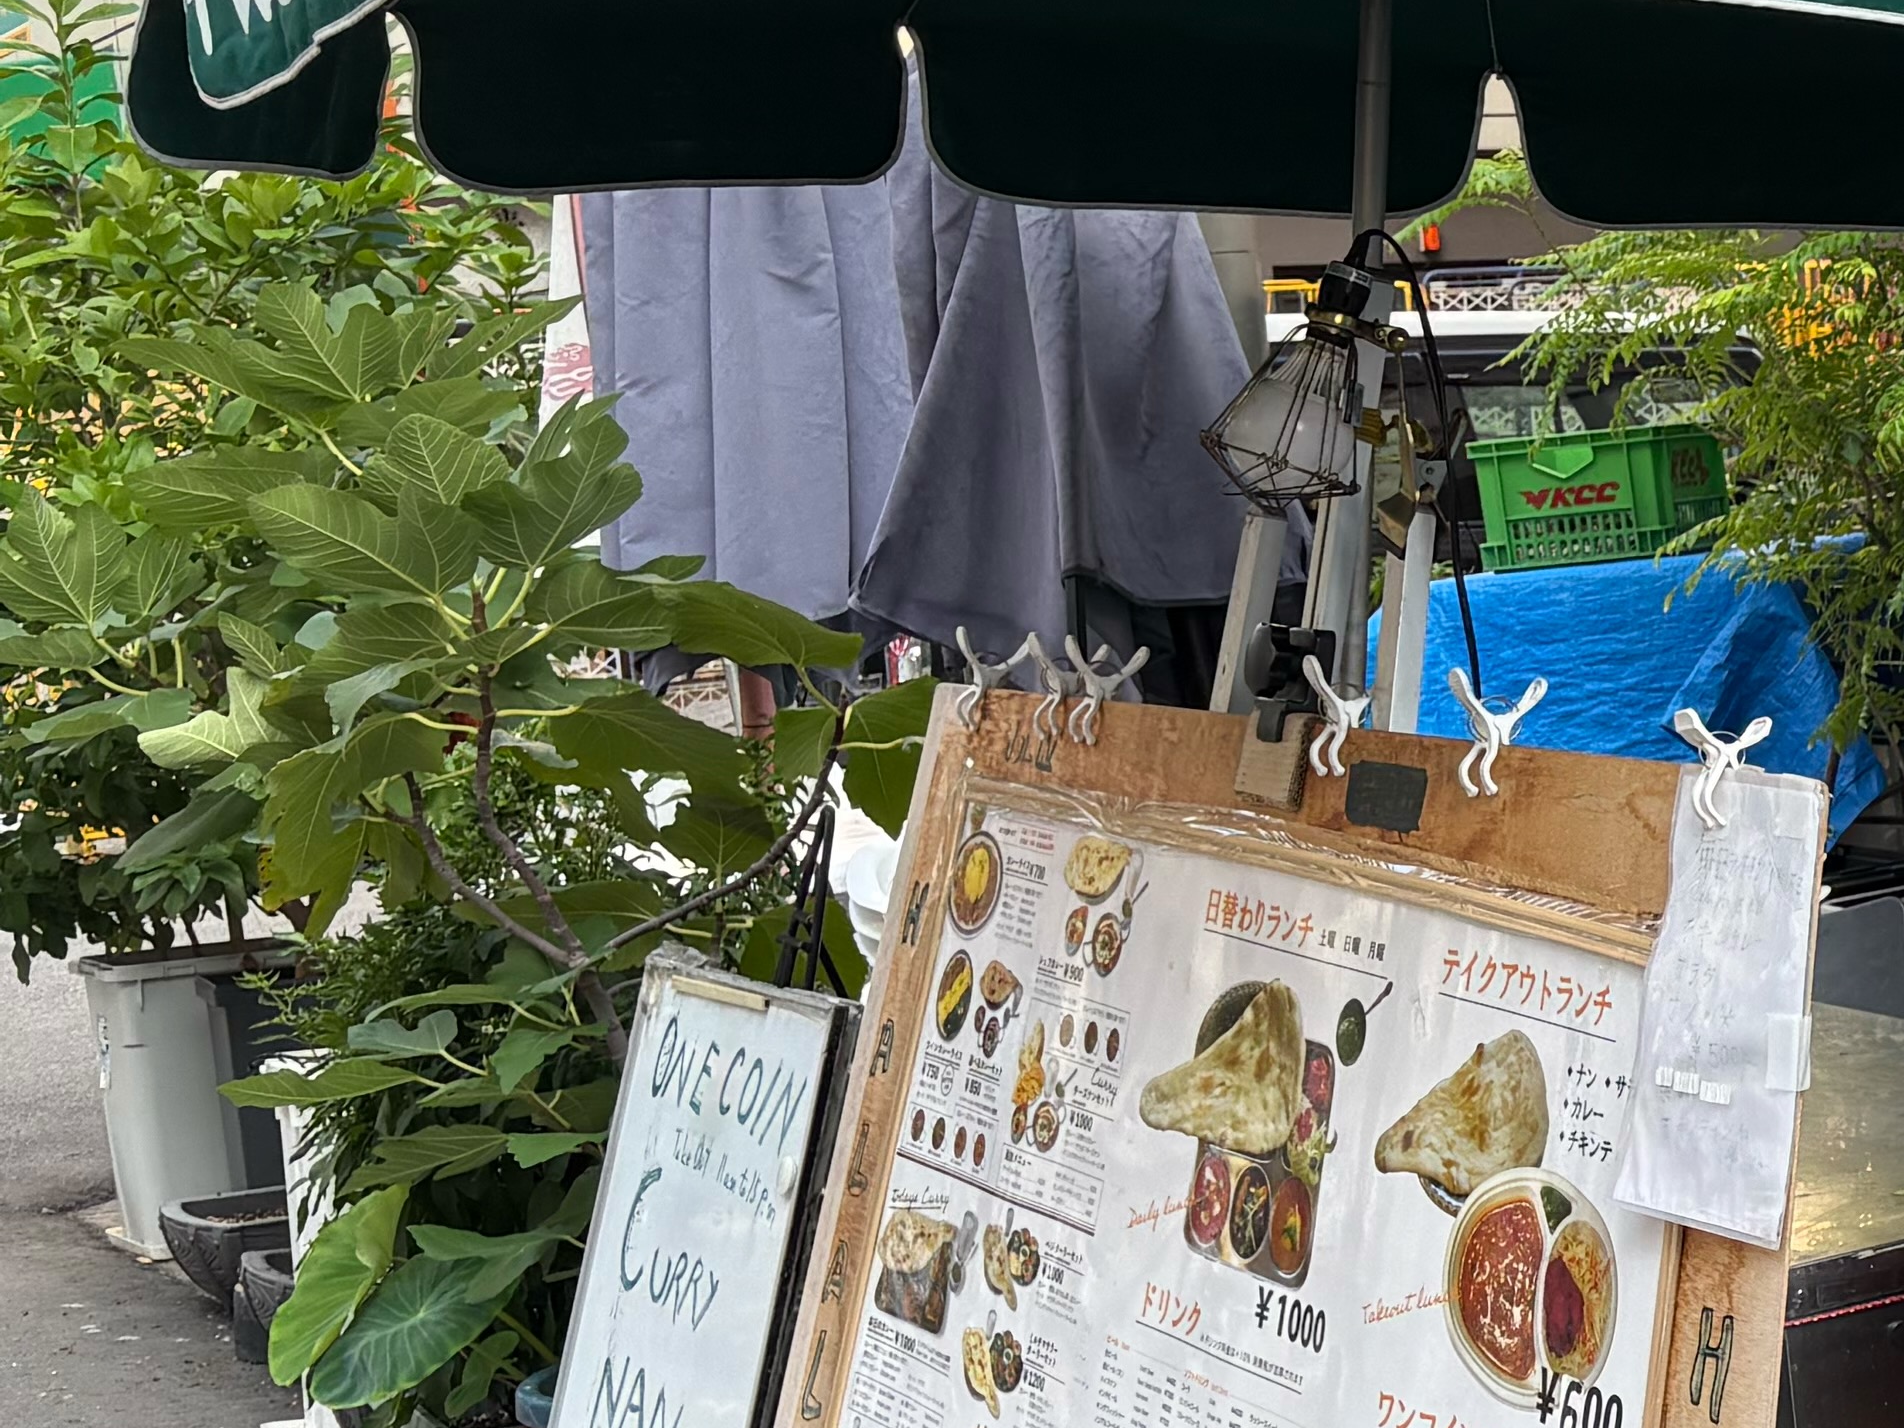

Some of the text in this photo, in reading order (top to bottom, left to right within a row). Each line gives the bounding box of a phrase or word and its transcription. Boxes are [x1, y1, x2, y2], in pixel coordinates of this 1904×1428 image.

[1204, 888, 1314, 949] 日替わりランチ
[1441, 948, 1614, 1028] テイクアウトランチ
[651, 1010, 808, 1157] ONE COIN
[1141, 1281, 1202, 1337] ドリンク
[1254, 1284, 1327, 1354] ¥1000
